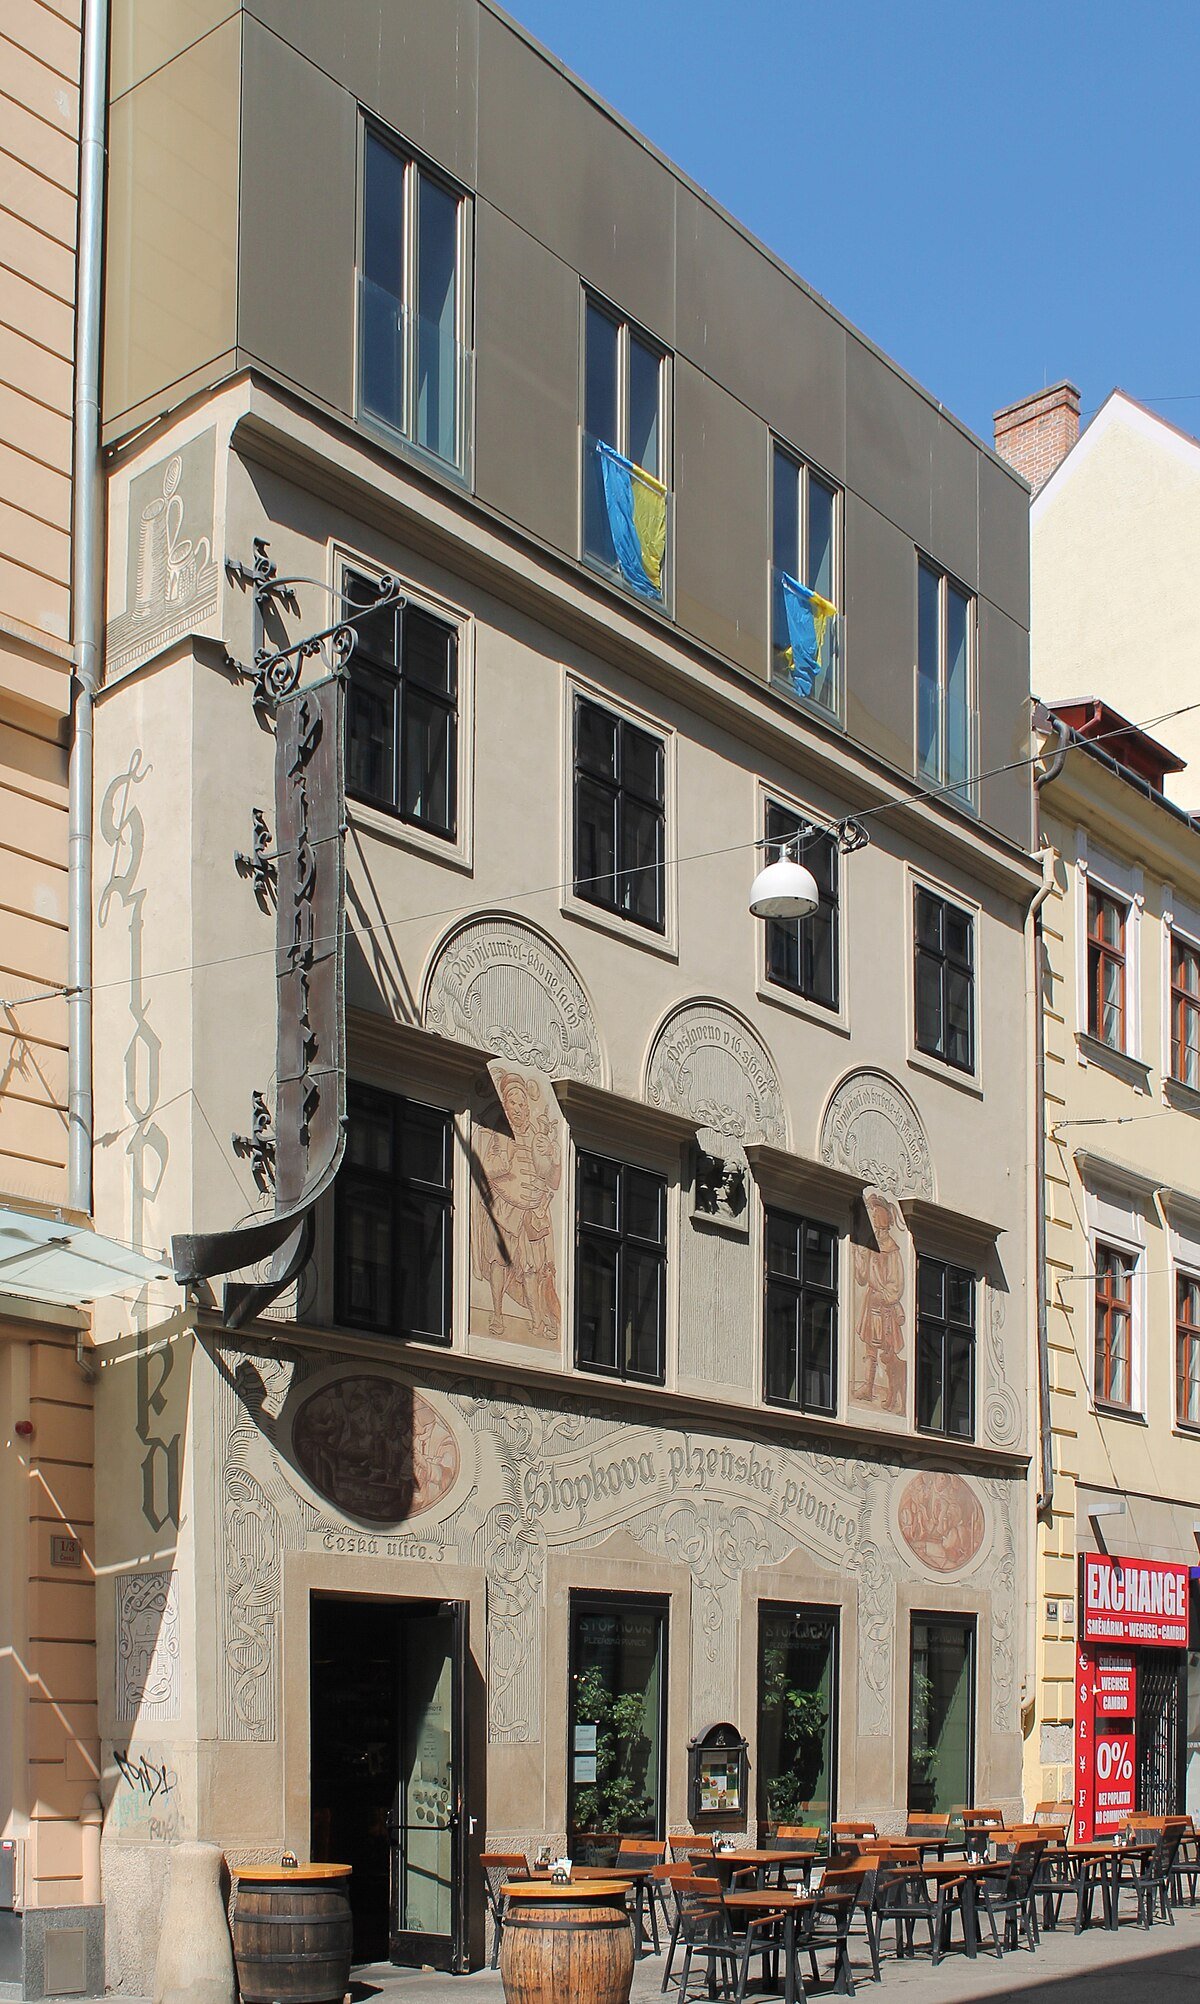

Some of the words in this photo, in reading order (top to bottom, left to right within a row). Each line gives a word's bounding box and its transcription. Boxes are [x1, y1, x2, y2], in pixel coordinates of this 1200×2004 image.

[523, 1451, 656, 1528] Stopkova
[668, 1431, 776, 1494] plzeňská
[780, 1477, 857, 1547] pivnice
[1087, 1563, 1186, 1617] EXCHANGE
[1087, 1617, 1124, 1637] SMĚNÁRNA
[1128, 1622, 1158, 1639] WECHSEL
[1161, 1625, 1186, 1641] CAMBIO
[1101, 1677, 1129, 1691] WECHSEL
[1103, 1696, 1128, 1710] CAMBIO
[1097, 1742, 1133, 1780] 0%
[1107, 1791, 1131, 1805] POPLATKU
[1095, 1811, 1103, 1824] NO
